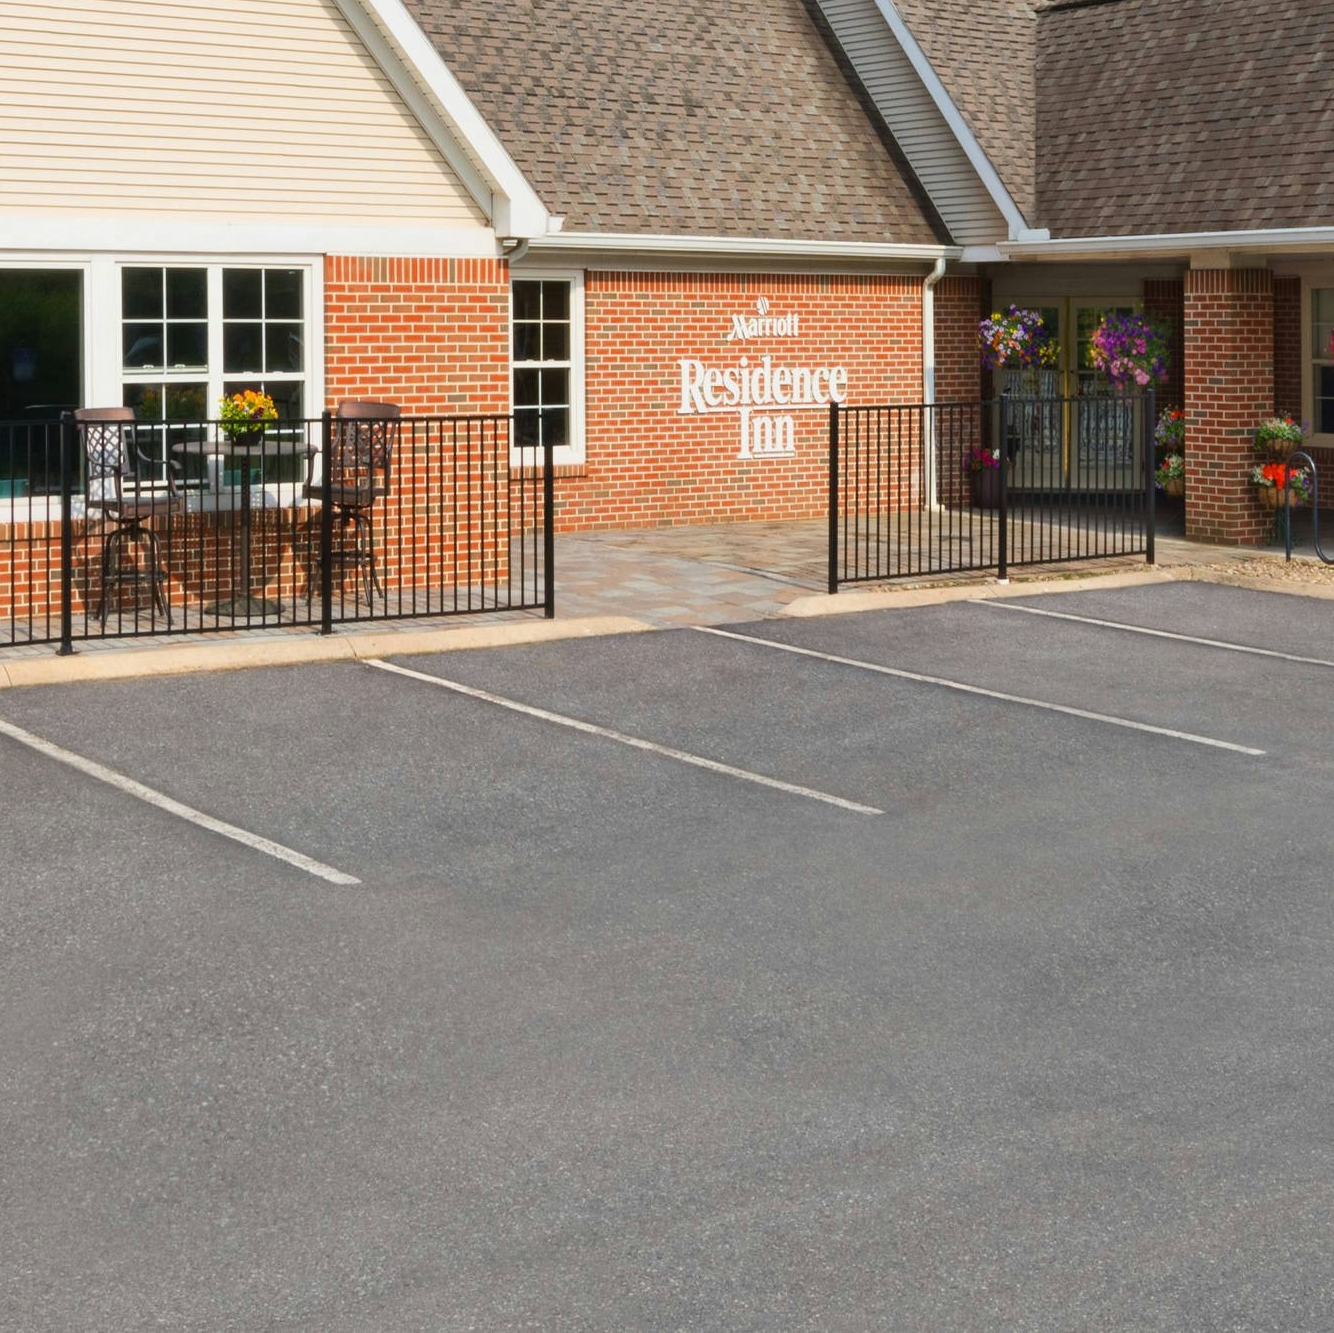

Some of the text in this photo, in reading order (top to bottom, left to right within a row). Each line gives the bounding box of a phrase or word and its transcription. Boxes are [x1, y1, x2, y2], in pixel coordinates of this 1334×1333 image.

[727, 313, 799, 341] Marriott
[677, 356, 848, 413] Residence
[737, 407, 796, 459] Inn
